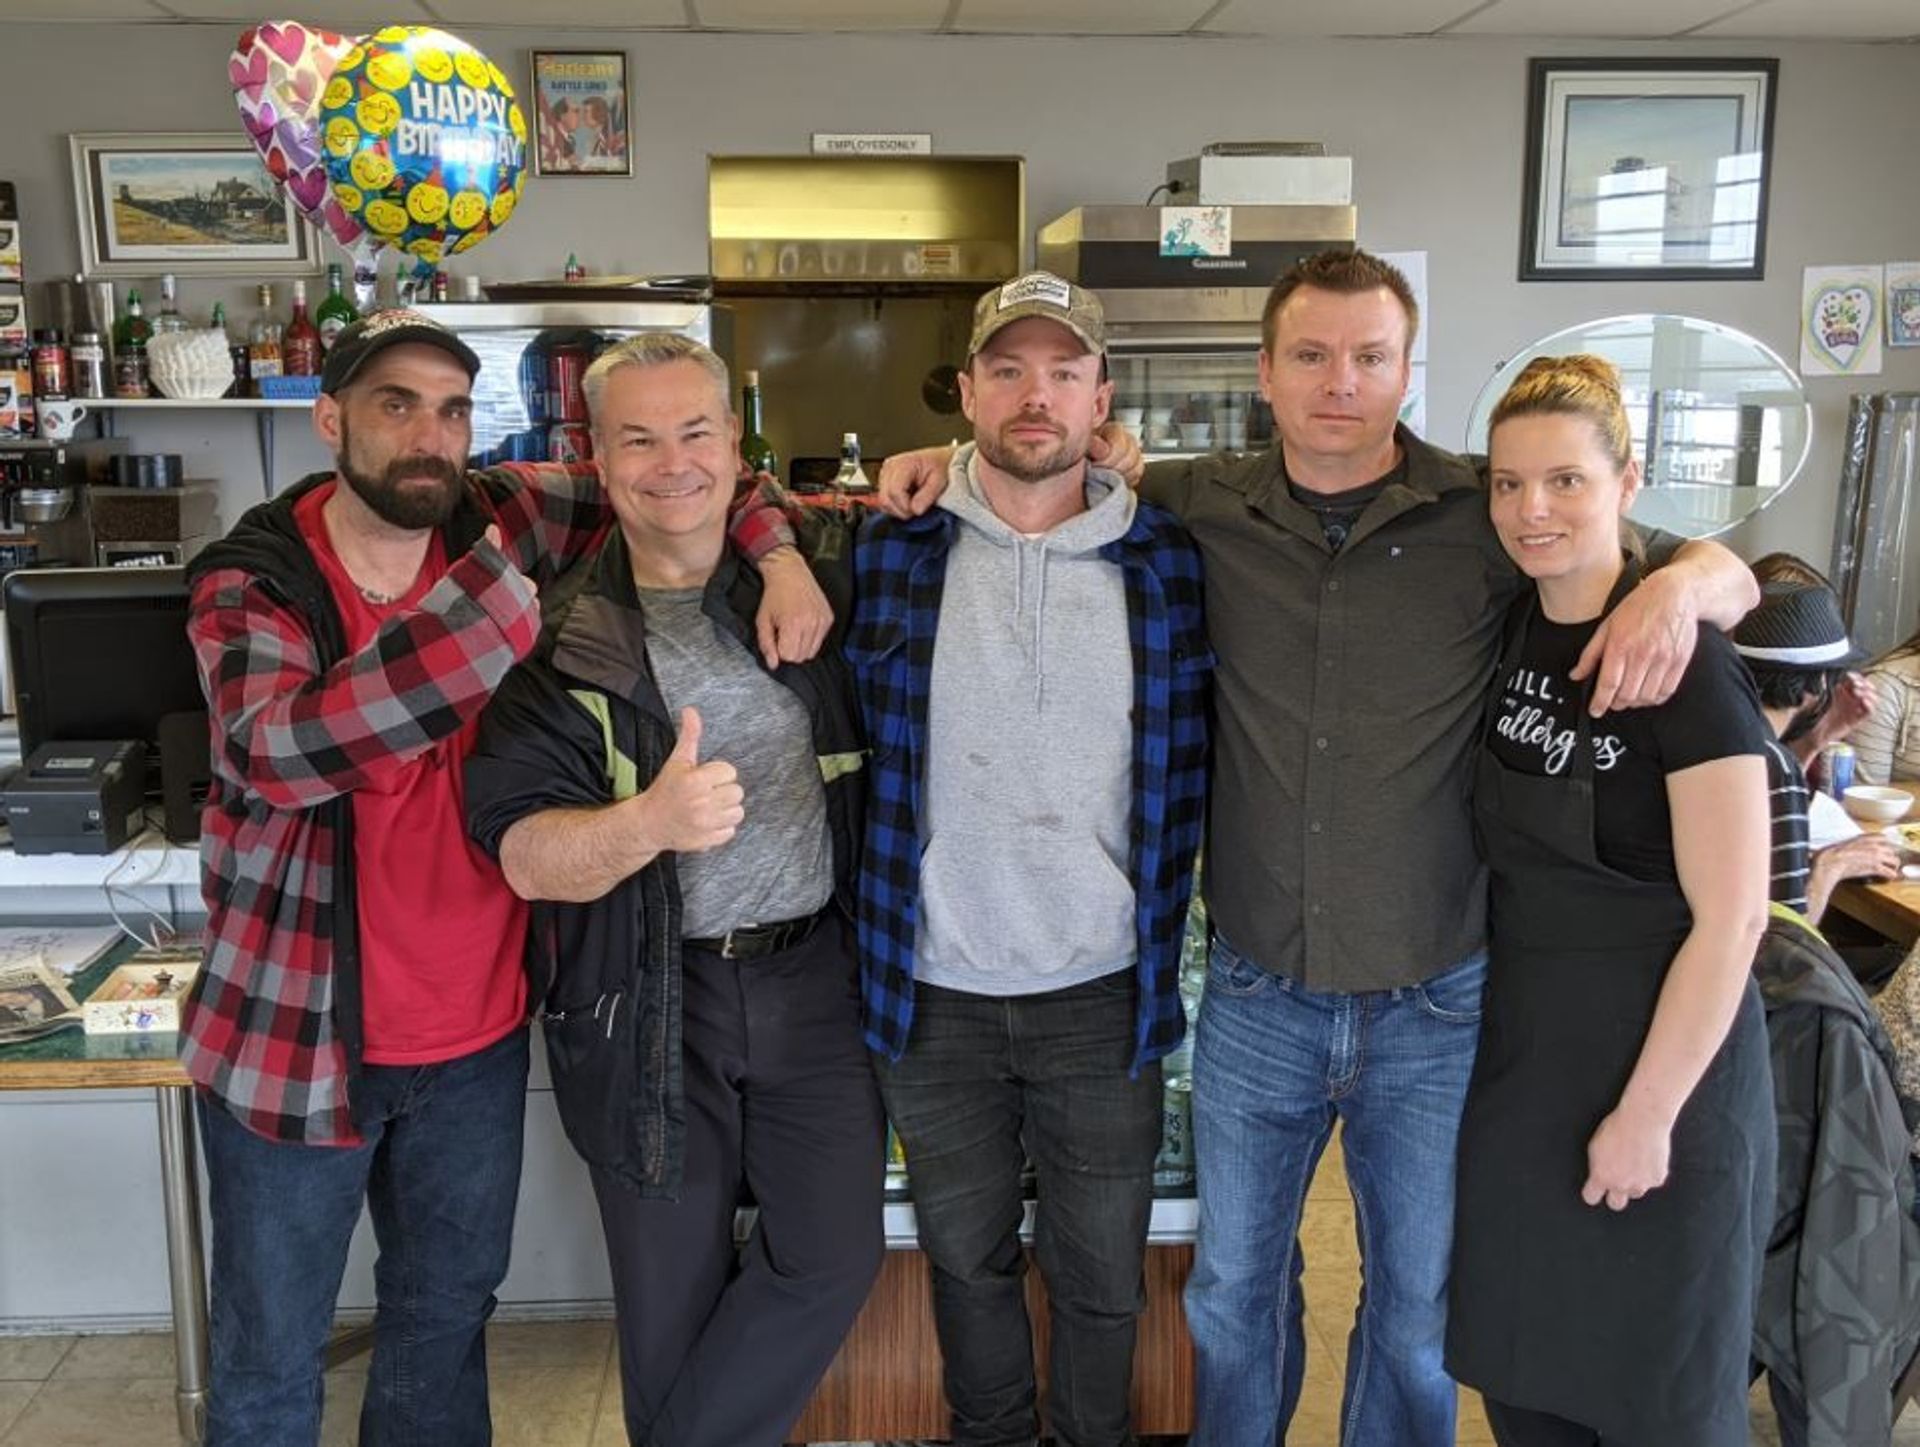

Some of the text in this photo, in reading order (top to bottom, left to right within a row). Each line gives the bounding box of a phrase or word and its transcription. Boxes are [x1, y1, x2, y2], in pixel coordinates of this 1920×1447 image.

[410, 81, 506, 129] HAPPY
[396, 118, 521, 168] BIRDAY
[1497, 705, 1627, 775] allerges
